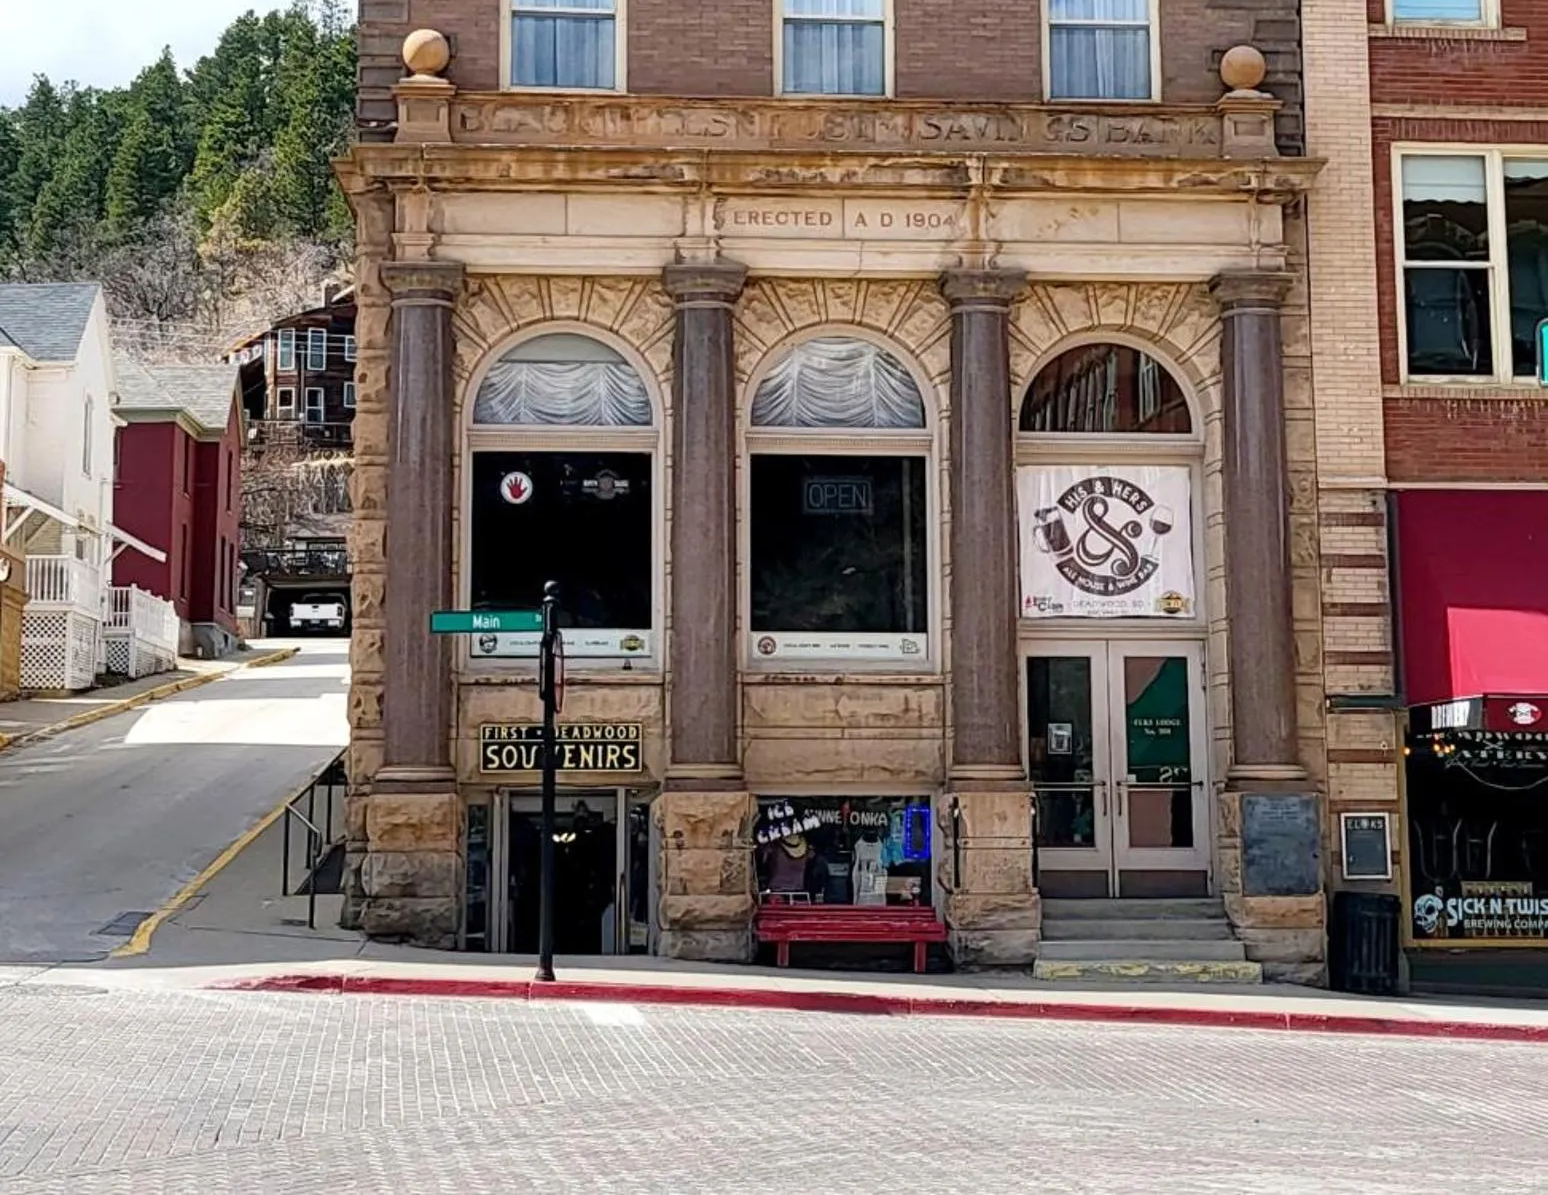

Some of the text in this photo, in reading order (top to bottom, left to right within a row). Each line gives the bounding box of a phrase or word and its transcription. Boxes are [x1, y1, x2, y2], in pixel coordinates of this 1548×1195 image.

[733, 211, 955, 228] ERECTED A D 1904
[808, 484, 867, 508] OPEN
[1065, 480, 1148, 511] HIS & HERS
[473, 614, 501, 629] Main
[485, 727, 529, 739] FIRST
[1463, 919, 1512, 929] BREWING
